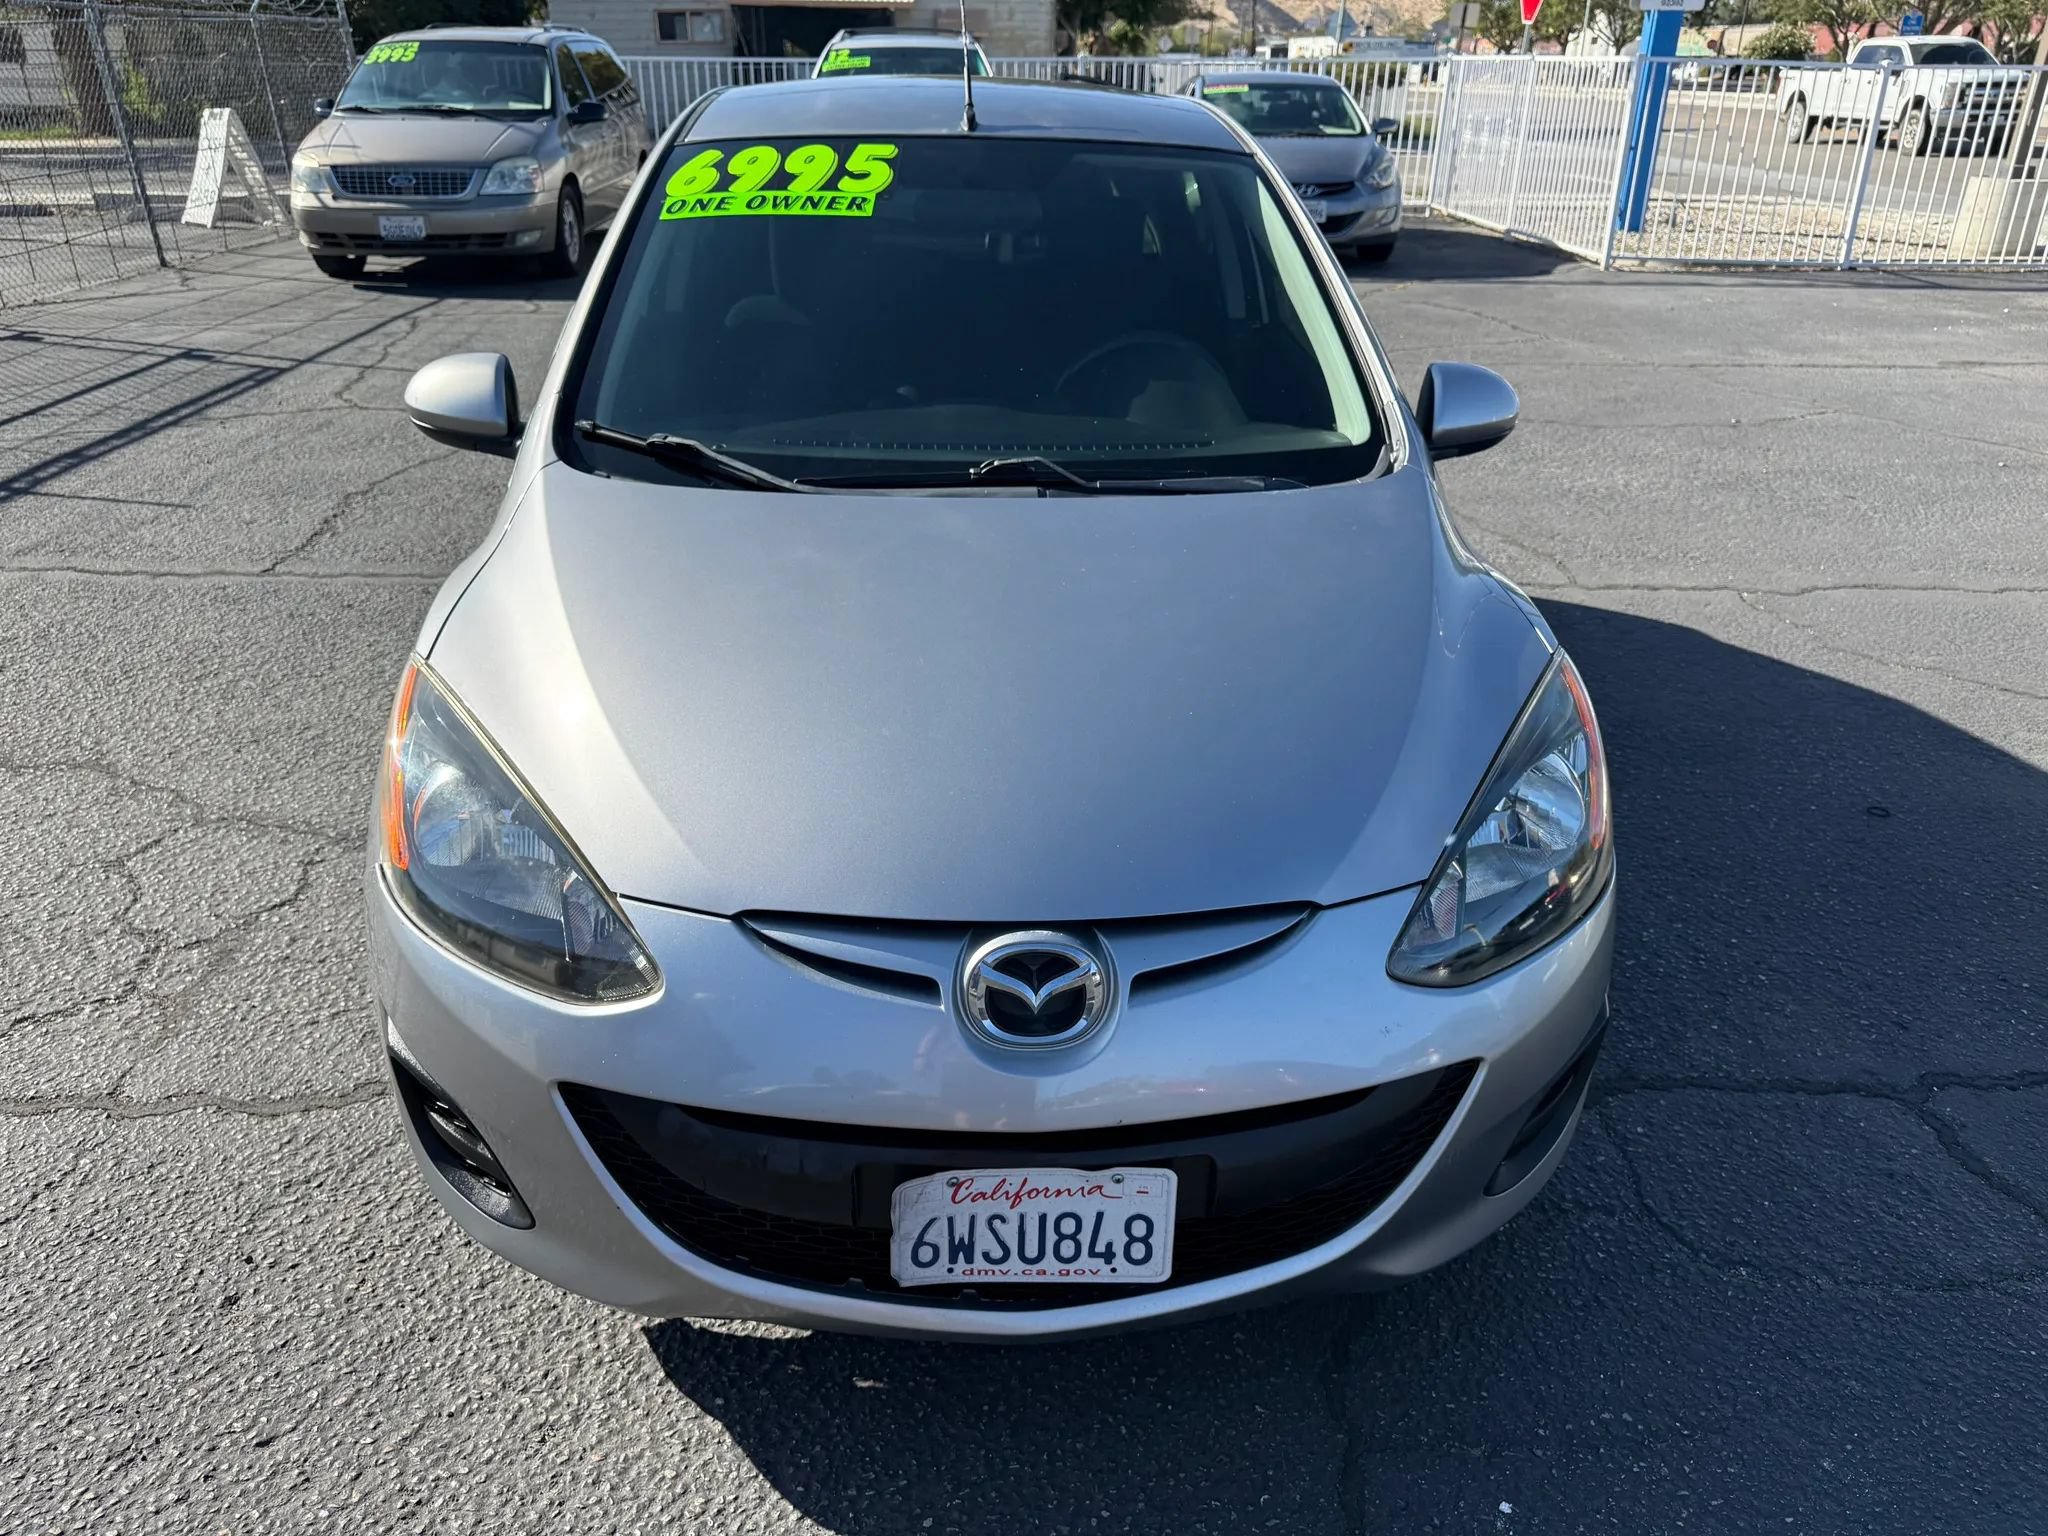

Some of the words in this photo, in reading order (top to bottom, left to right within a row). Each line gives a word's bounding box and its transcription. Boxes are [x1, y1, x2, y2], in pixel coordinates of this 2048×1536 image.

[665, 143, 899, 197] 6995
[665, 196, 738, 215] ONE
[744, 194, 872, 213] OWNER
[950, 1177, 1123, 1210] California
[910, 1211, 1155, 1269] 6WSU848
[961, 1266, 1101, 1277] dmv.ca.gov
